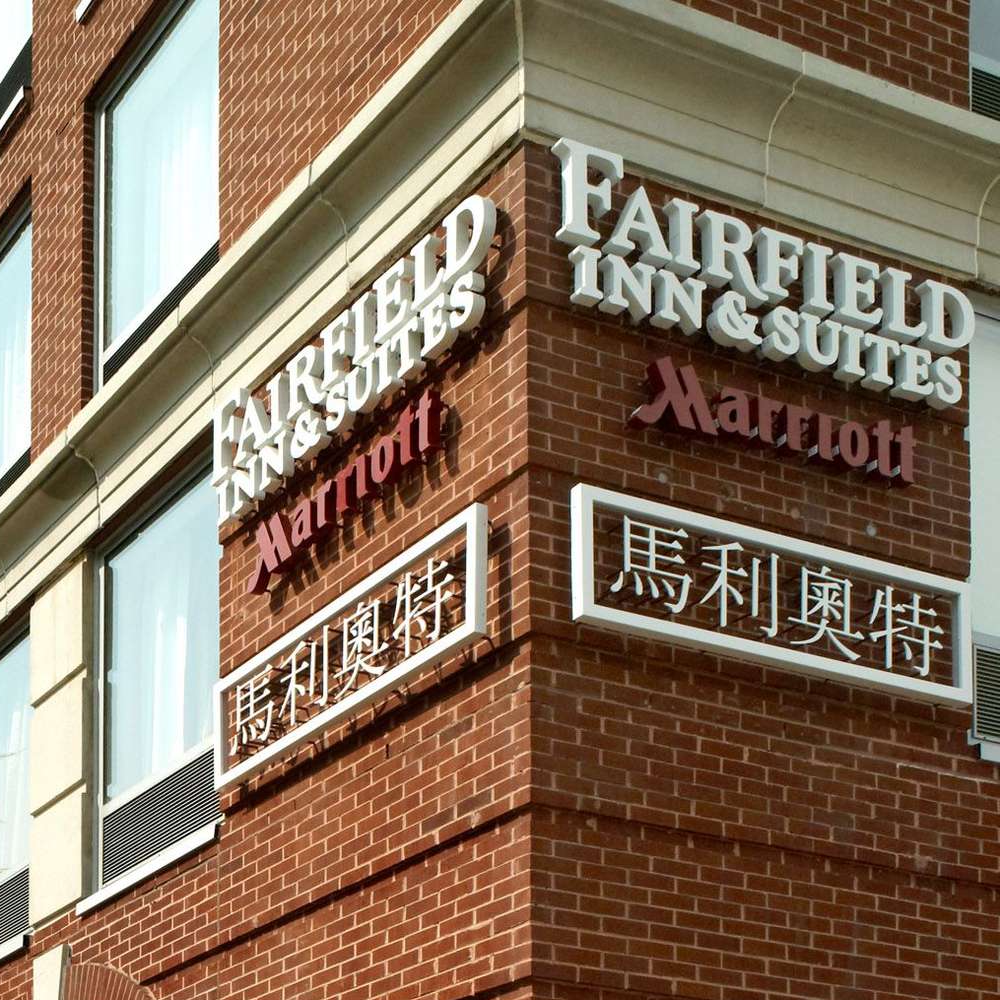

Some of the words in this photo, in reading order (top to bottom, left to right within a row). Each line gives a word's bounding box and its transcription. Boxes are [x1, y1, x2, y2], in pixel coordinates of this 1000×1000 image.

[211, 195, 496, 486] FAIRFIELD
[551, 137, 975, 354] FAIRFIELD
[250, 388, 441, 594] Marriott
[626, 356, 916, 484] Marriott
[229, 557, 455, 756] 馬利奧特
[610, 514, 945, 677] 馬利奧特
